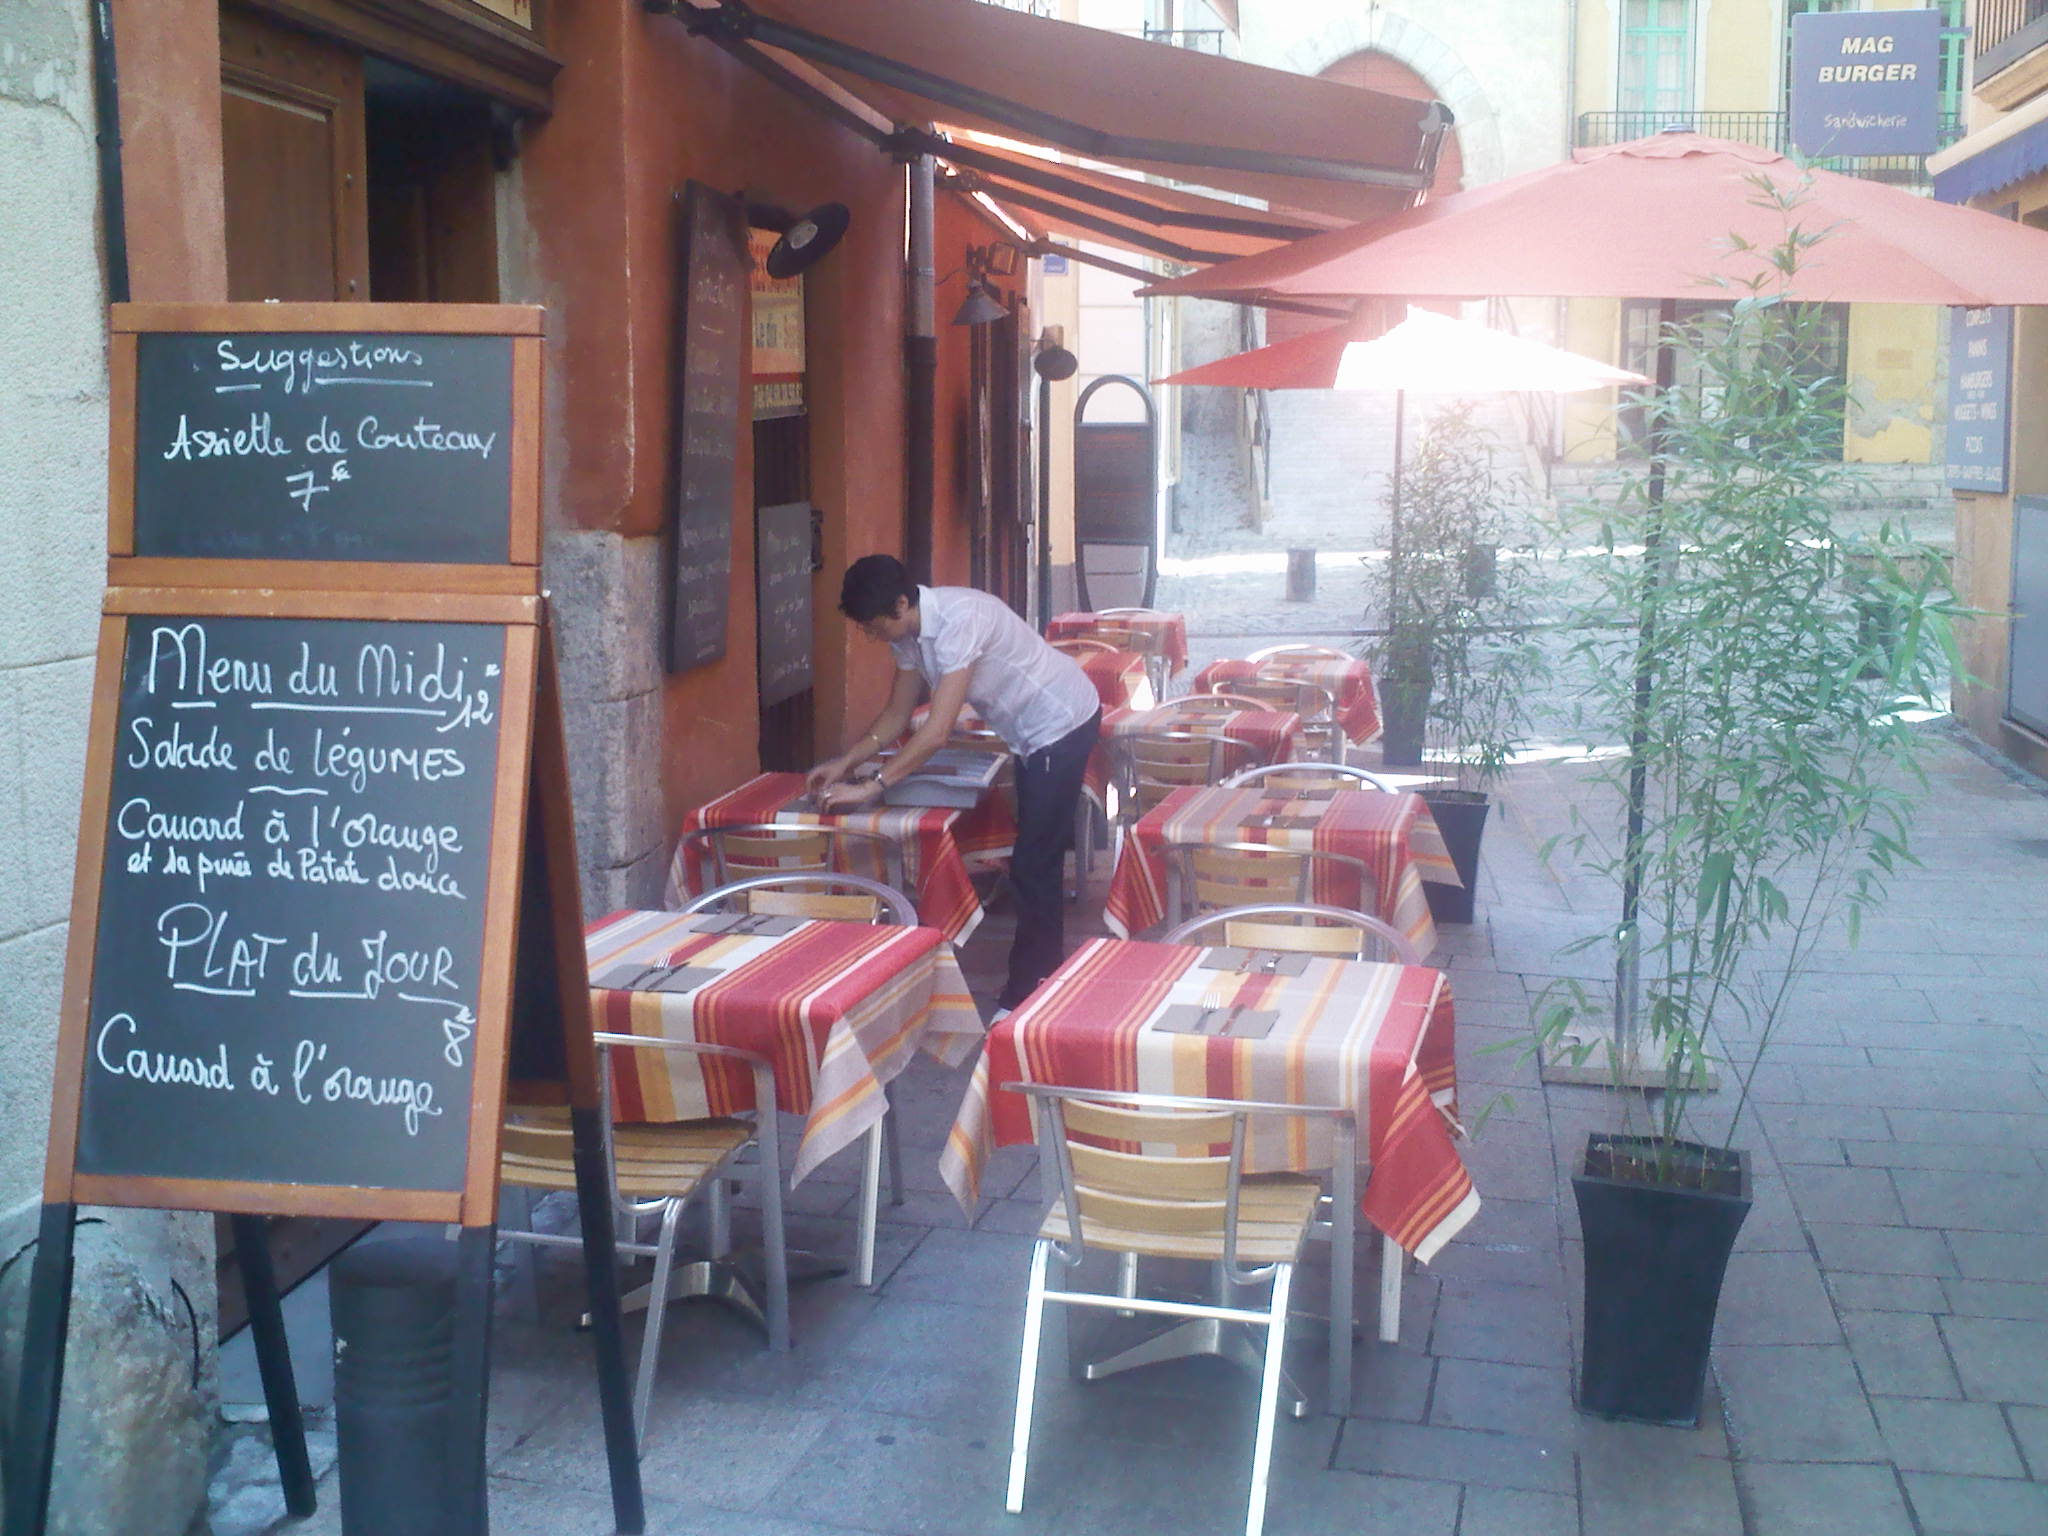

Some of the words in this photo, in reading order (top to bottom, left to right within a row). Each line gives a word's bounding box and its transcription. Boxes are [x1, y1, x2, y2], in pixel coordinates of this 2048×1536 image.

[1841, 36, 1894, 54] MAG
[1818, 64, 1917, 83] BURGER
[216, 339, 424, 393] Suggestions
[305, 416, 350, 455] de
[148, 623, 272, 695] Menu
[288, 642, 339, 696] du
[358, 643, 469, 703] Midi
[128, 717, 238, 771] Salade
[254, 727, 296, 774] de
[117, 798, 245, 840] Canard
[264, 810, 290, 842] à
[127, 842, 152, 874] et
[267, 848, 294, 880] de
[157, 902, 288, 987] PLAT
[293, 931, 342, 985] du
[96, 1013, 234, 1090] Canard
[250, 1053, 279, 1096] à
